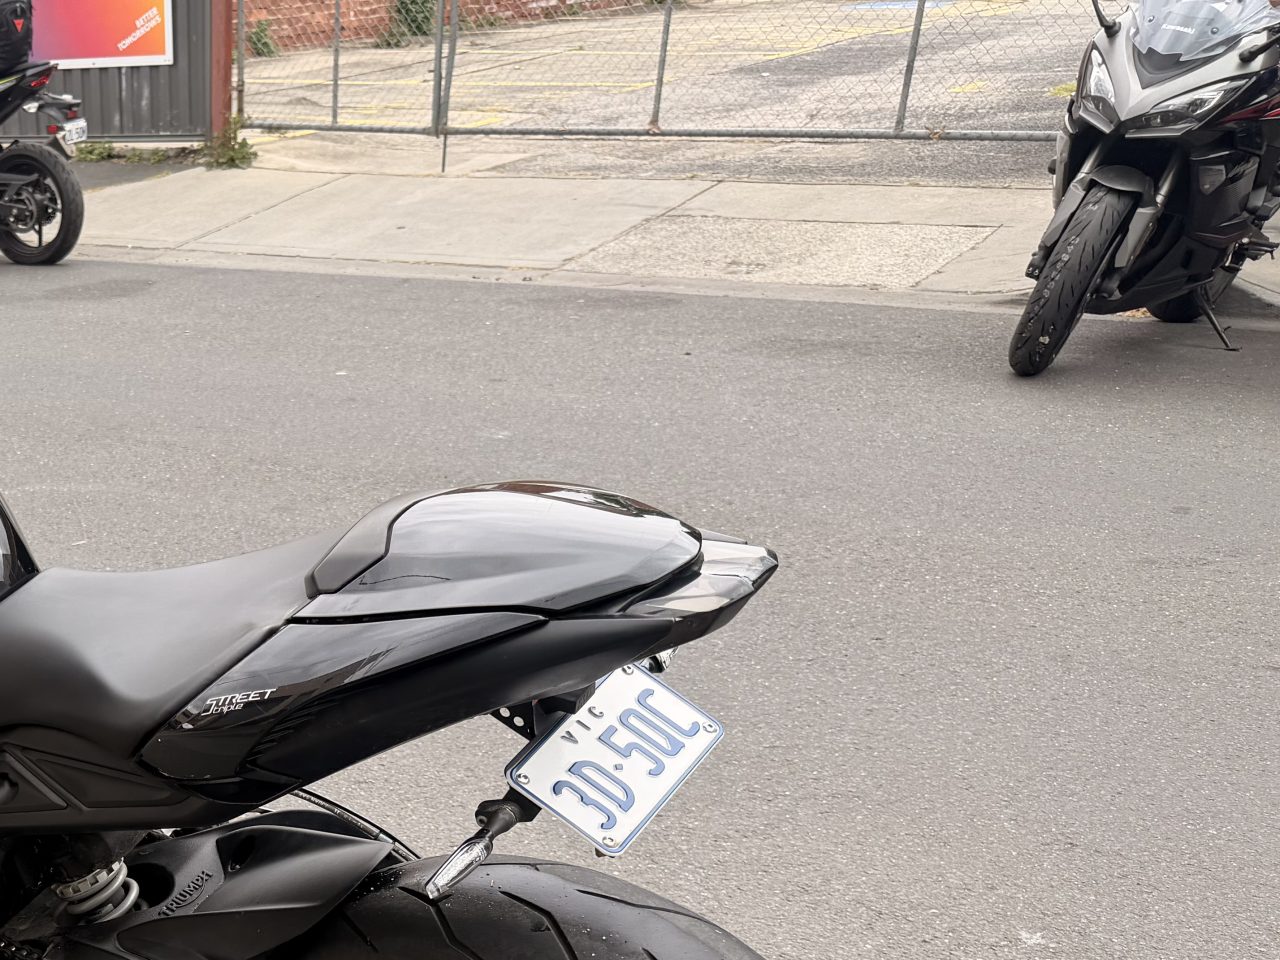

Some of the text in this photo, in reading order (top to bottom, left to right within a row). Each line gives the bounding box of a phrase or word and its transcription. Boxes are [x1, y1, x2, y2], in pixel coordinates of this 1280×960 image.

[1161, 23, 1195, 34] Kawasaki
[200, 688, 277, 716] STREET
[560, 705, 605, 745] VIC
[157, 869, 214, 917] TRIUMPH
